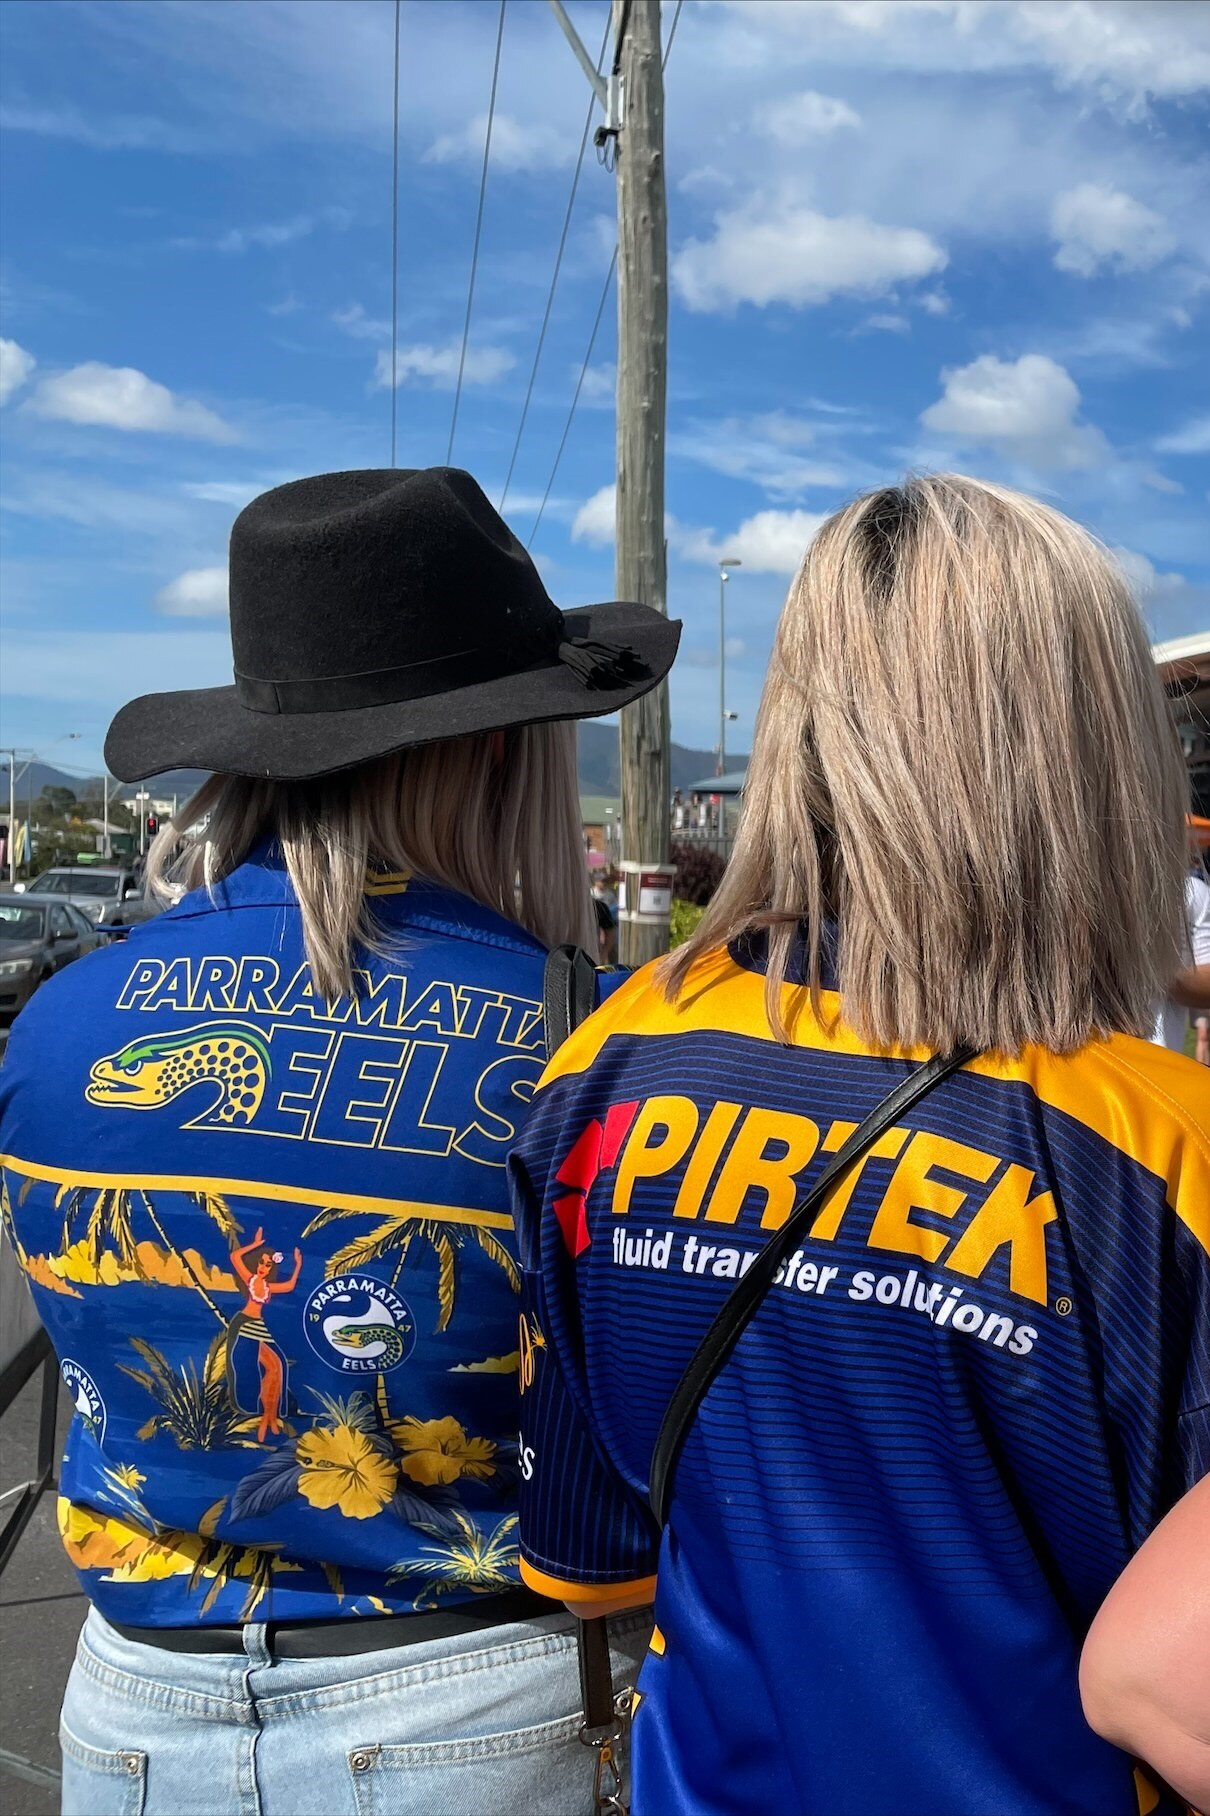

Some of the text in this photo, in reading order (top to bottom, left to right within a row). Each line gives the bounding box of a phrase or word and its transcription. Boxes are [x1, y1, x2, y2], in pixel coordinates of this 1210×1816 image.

[264, 1023, 548, 1168] EELS
[611, 1095, 1059, 1308] PIRTEK
[311, 1278, 407, 1321] PARRAMATTA
[612, 1227, 674, 1270] fluid
[848, 1268, 1040, 1356] solutions
[309, 1313, 320, 1323] 19
[397, 1324, 412, 1333] 47
[341, 1358, 377, 1370] EELS
